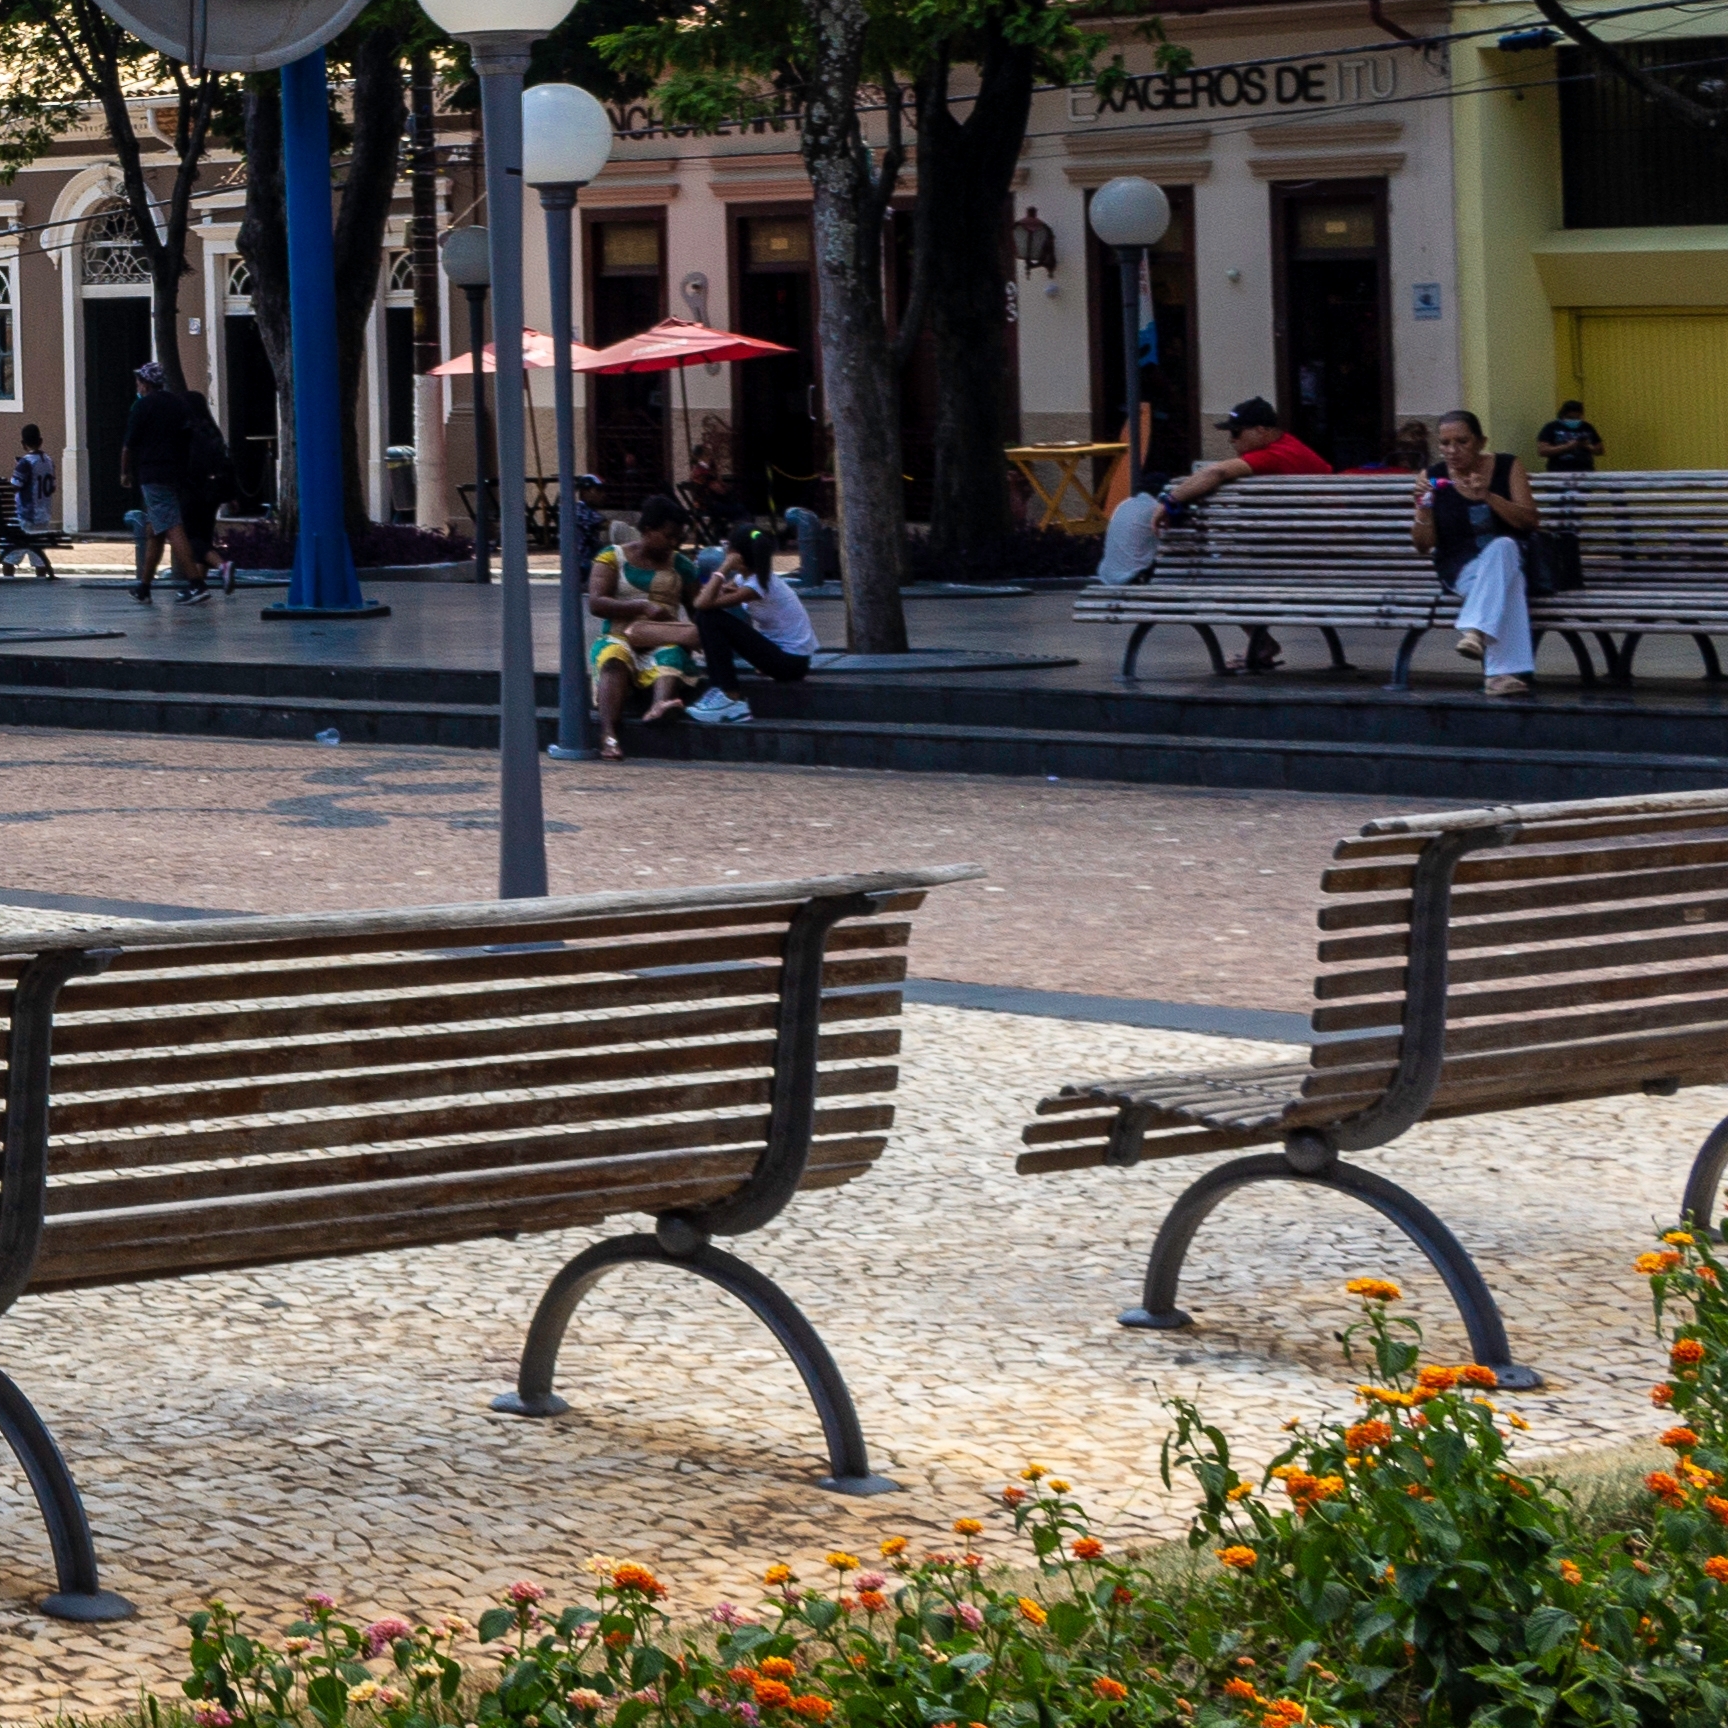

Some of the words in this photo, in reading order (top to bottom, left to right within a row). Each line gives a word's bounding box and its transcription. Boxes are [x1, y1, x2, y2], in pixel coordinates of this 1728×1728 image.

[1275, 63, 1326, 103] DE
[1336, 56, 1398, 101] ITU
[37, 474, 54, 500] 10
